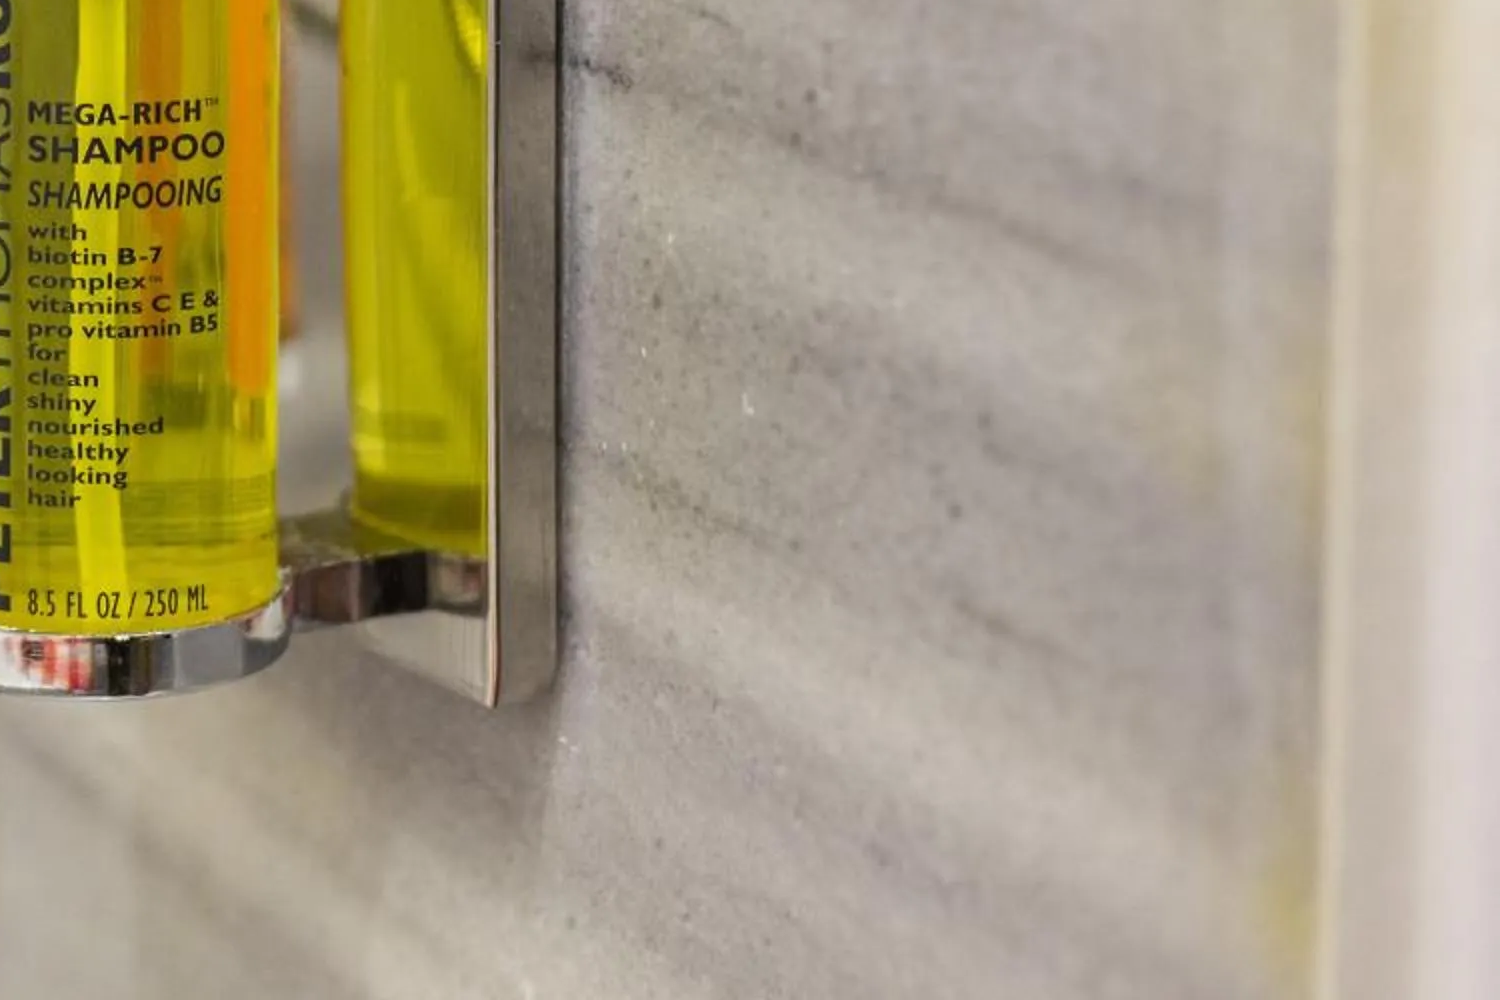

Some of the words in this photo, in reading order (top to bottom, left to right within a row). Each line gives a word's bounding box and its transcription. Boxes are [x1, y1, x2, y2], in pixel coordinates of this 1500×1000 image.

[27, 130, 225, 164] SHAMPOO
[27, 175, 223, 210] SHAMPOOING
[27, 223, 87, 242] with
[27, 246, 107, 266] biotin
[117, 246, 163, 266] B-7
[27, 295, 143, 315] vitamins
[151, 295, 171, 313] C
[180, 292, 195, 311] E
[203, 289, 219, 308] &
[27, 323, 73, 341] pro
[82, 317, 181, 340] vitamin
[190, 313, 218, 335] B5
[27, 343, 67, 362] for
[27, 369, 100, 388] clean
[27, 392, 97, 416] shiny
[27, 416, 164, 437] nourished
[27, 439, 130, 465] healthy
[27, 463, 129, 489] looking
[27, 487, 81, 508] hair
[26, 588, 57, 617] 8.5
[66, 591, 88, 619] FL
[96, 591, 121, 620] OZ
[144, 588, 180, 618] 250
[187, 583, 209, 613] ML
